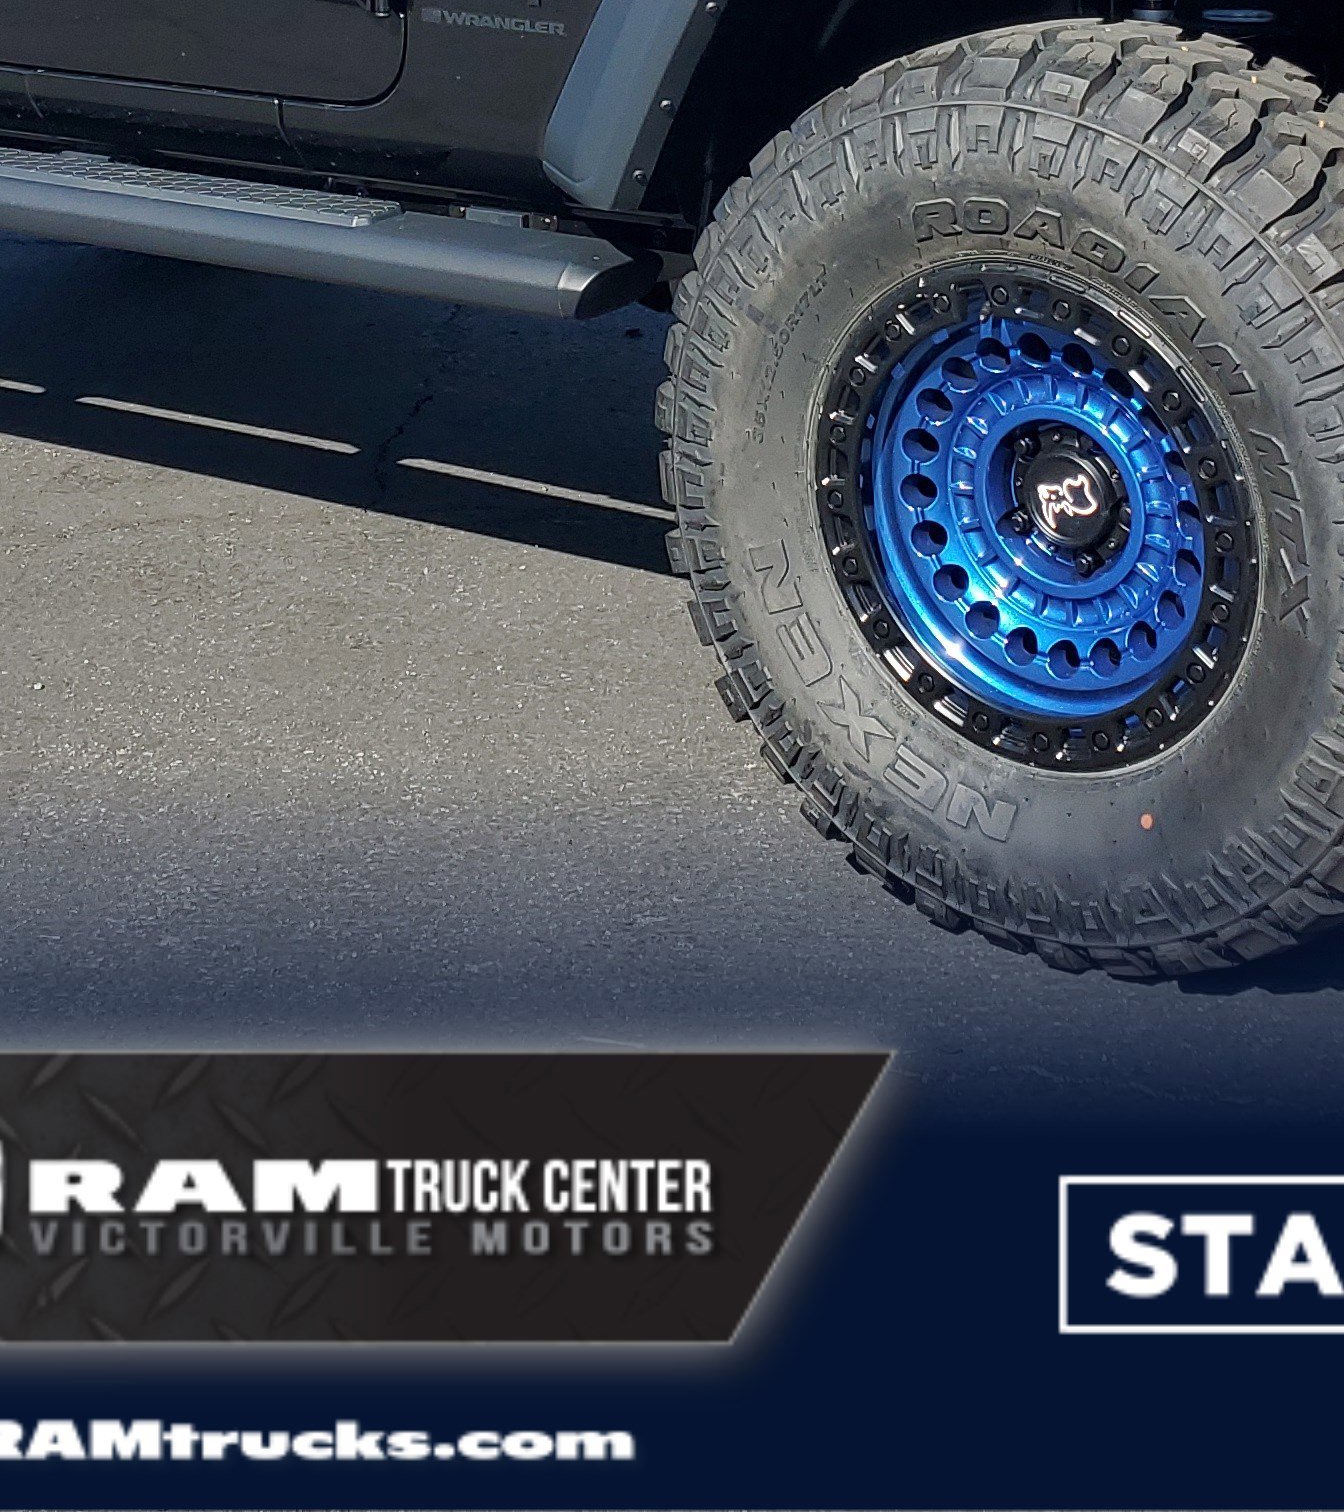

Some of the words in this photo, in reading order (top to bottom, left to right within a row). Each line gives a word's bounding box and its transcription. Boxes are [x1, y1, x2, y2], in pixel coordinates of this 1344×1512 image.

[442, 9, 566, 37] WRANGLER
[912, 196, 1256, 396] ROADIAN
[747, 537, 1018, 842] NEXEN
